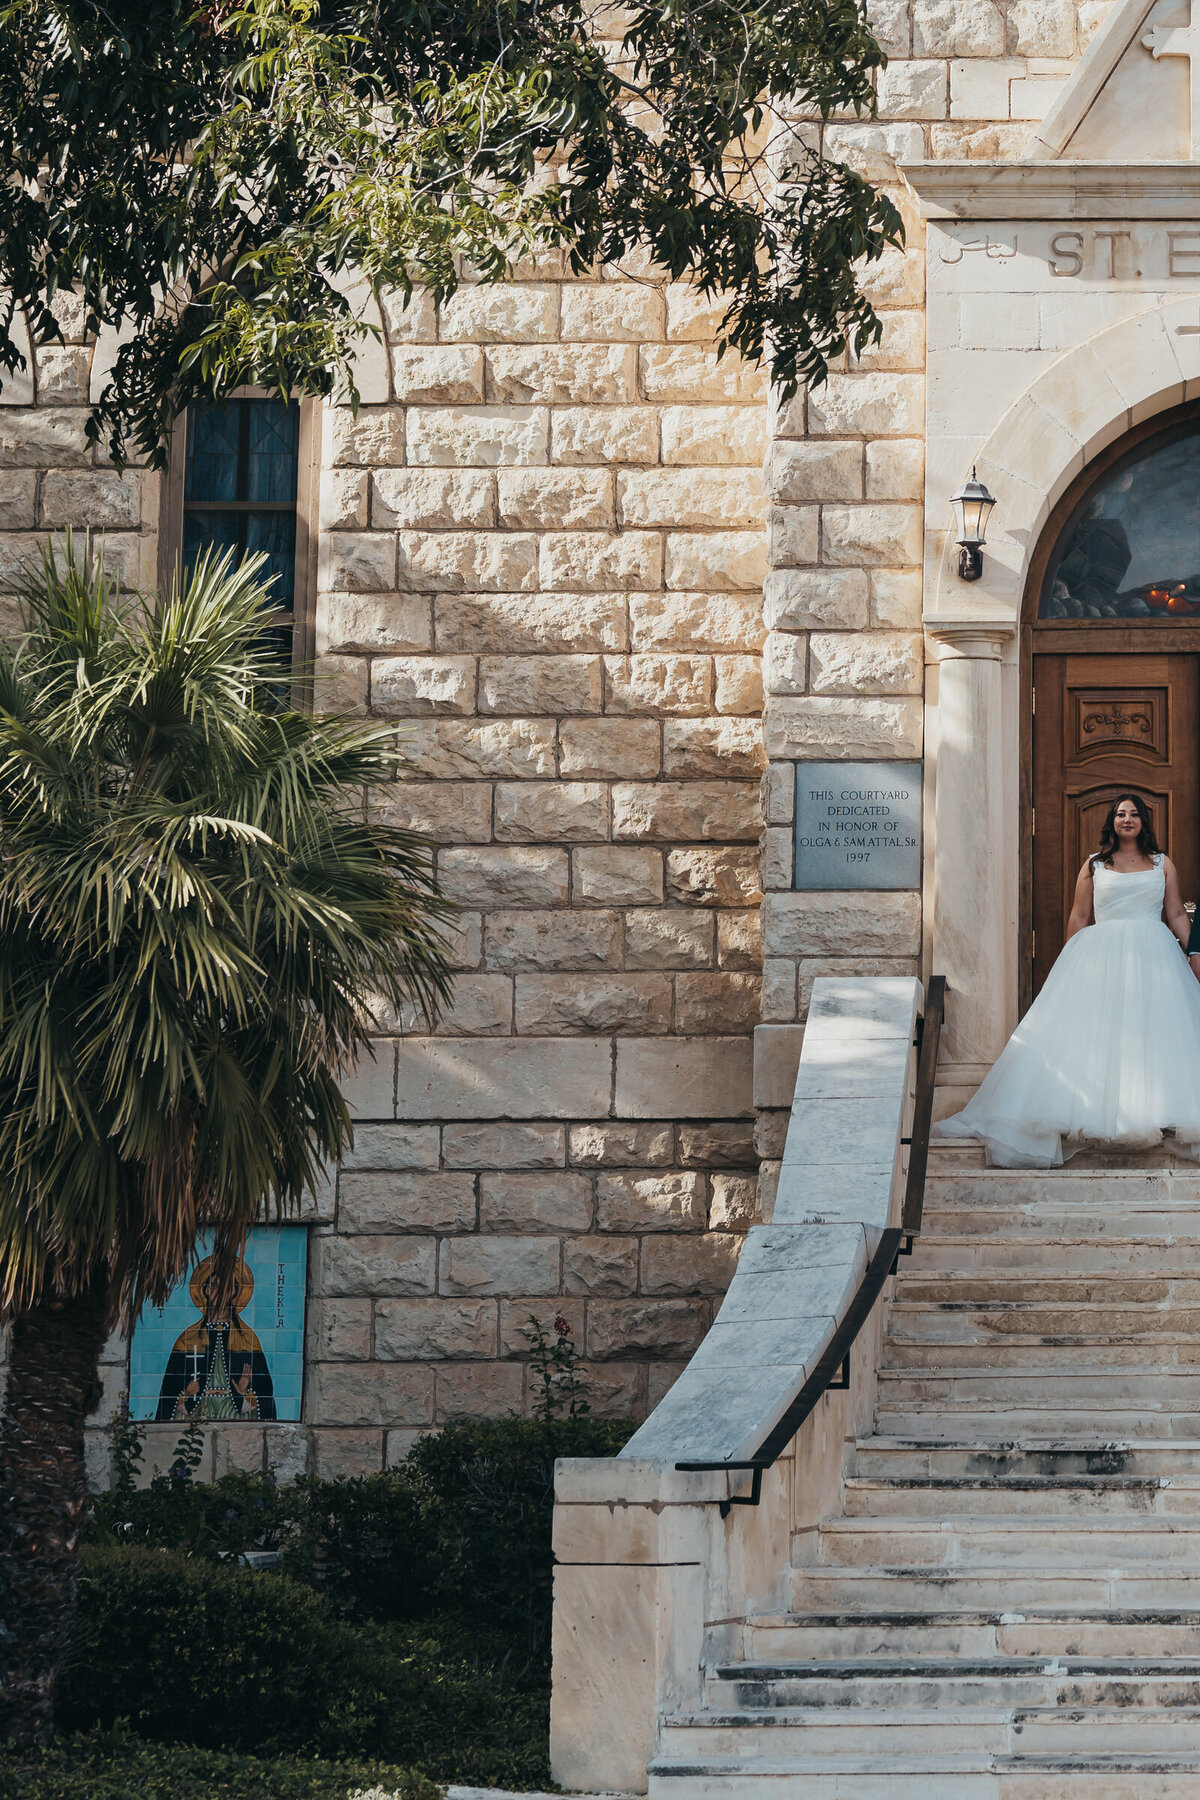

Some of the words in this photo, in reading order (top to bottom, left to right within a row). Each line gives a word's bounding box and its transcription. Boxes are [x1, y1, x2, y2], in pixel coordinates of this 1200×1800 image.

[1047, 230, 1143, 279] ST.
[808, 790, 834, 800] THIS
[840, 790, 910, 800] COURTYARD
[827, 806, 891, 816] DEDICATED
[818, 821, 830, 832] IN
[835, 821, 878, 832] HONOR
[883, 821, 899, 832] OF
[800, 837, 832, 847] OLGA
[834, 837, 841, 847] &
[843, 837, 866, 847] SAM
[867, 837, 904, 848] ATTAL,
[846, 852, 871, 863] 1997
[275, 1263, 286, 1329] THEKLA
